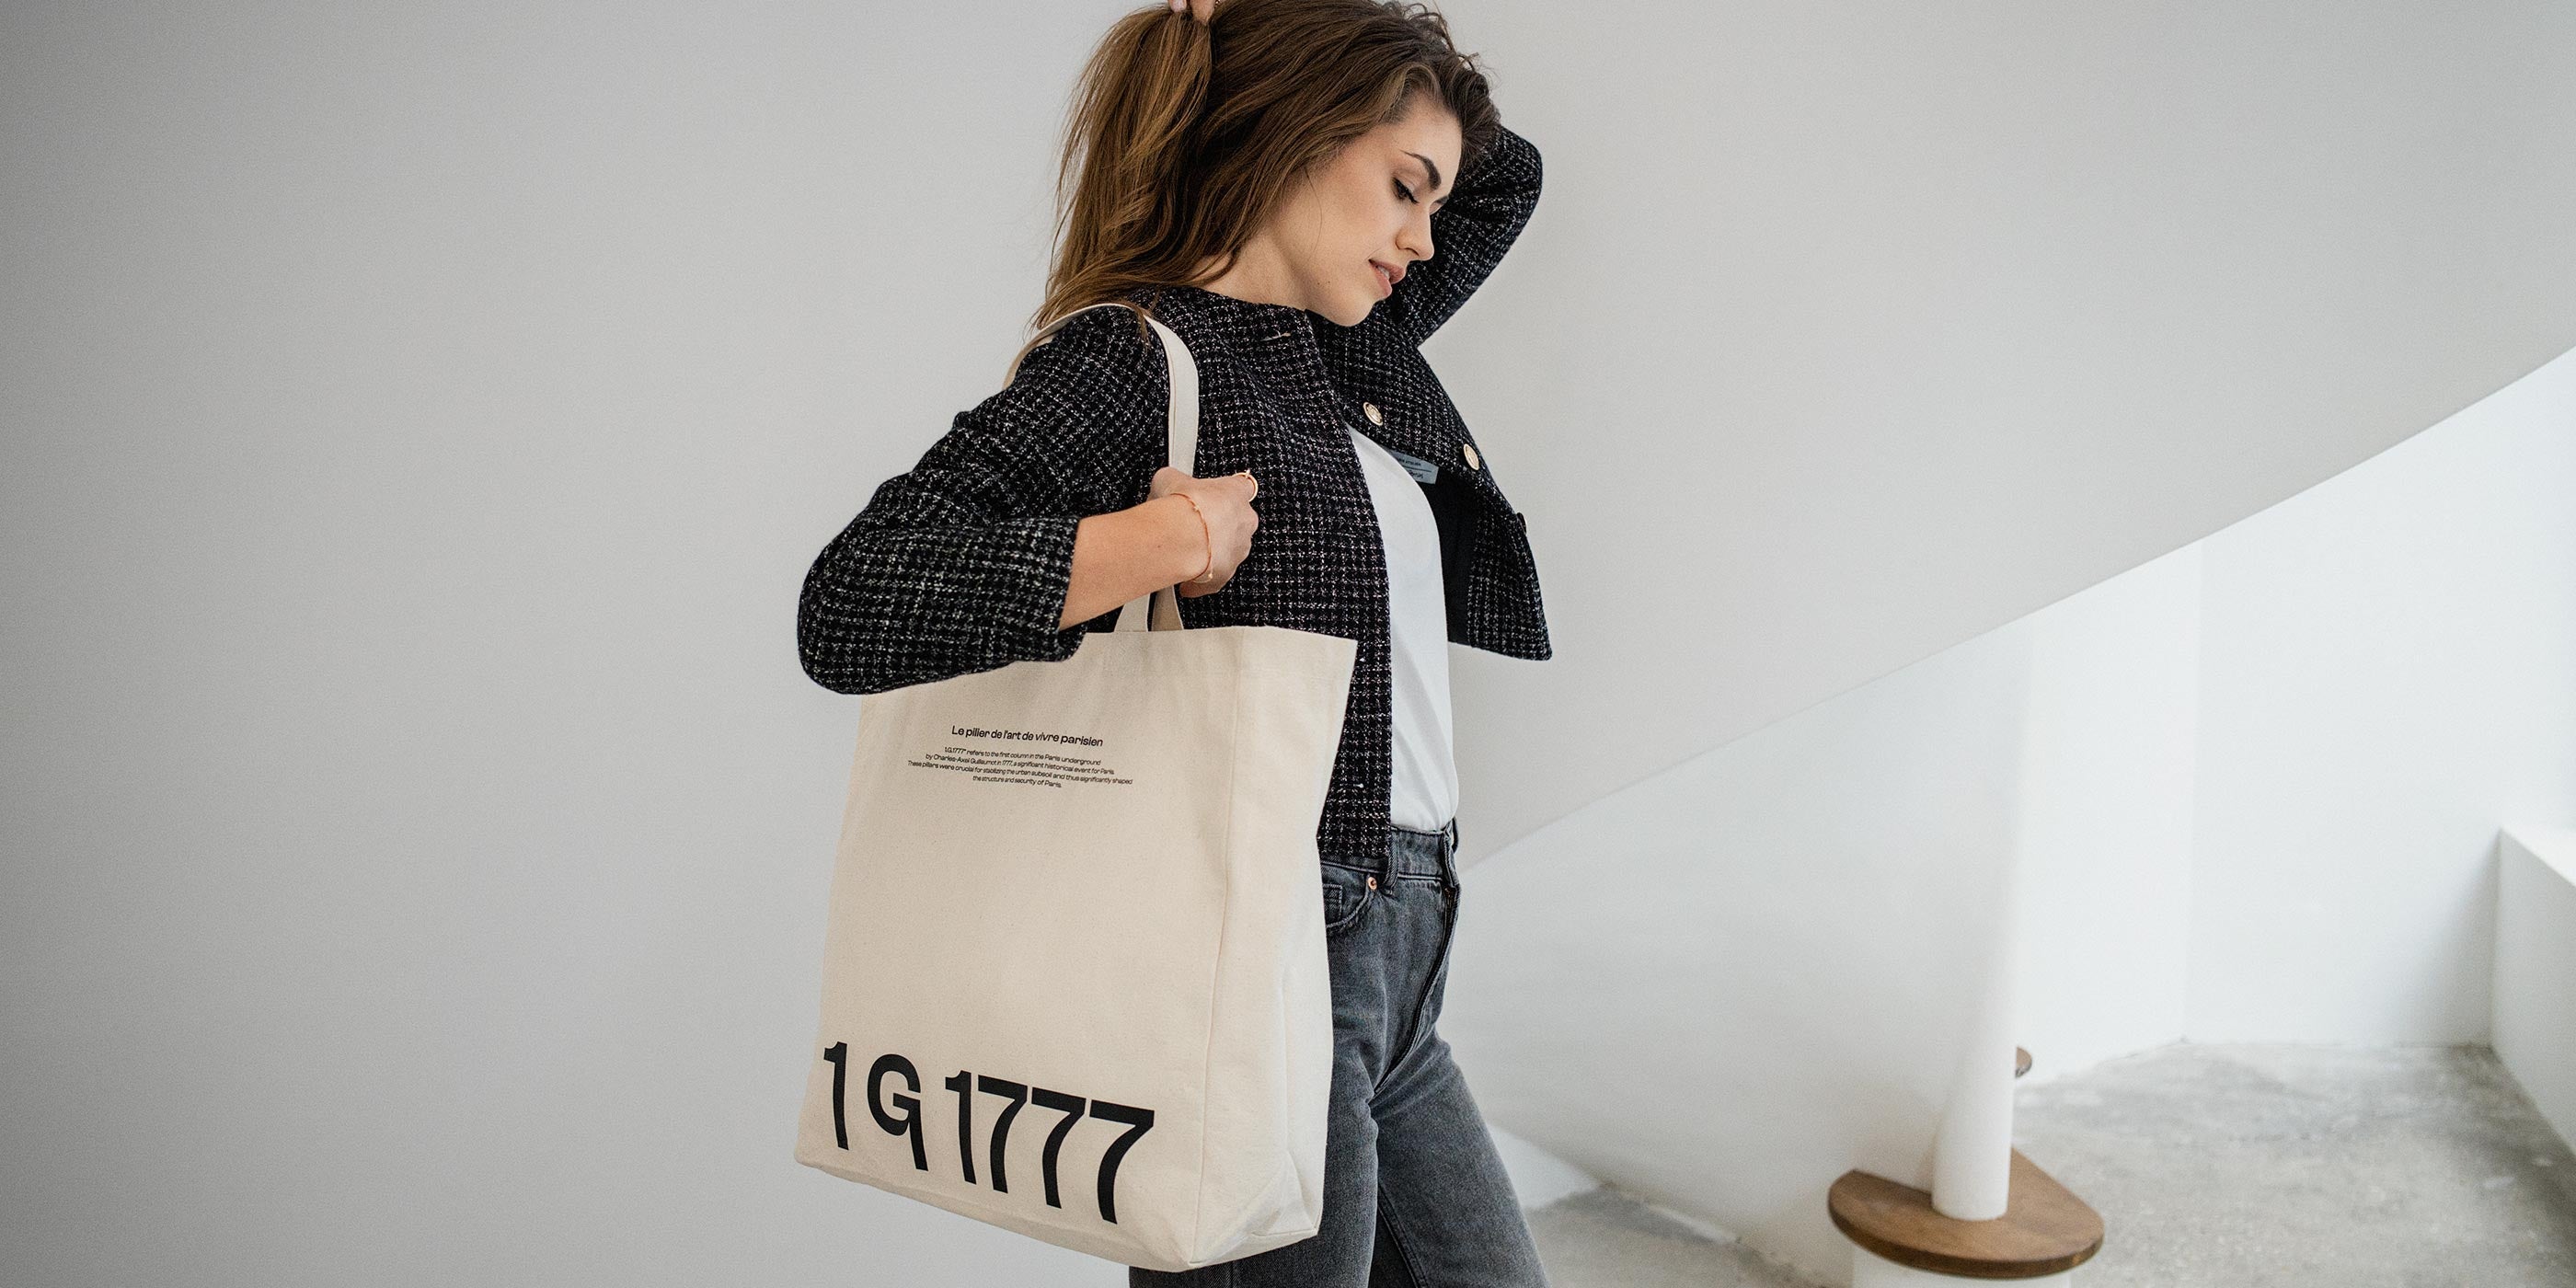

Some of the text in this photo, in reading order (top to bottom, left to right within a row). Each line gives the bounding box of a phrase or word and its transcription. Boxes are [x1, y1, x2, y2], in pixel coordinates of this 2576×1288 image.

[952, 725, 1103, 747] Le pilier de l'art de vivre parisien
[1061, 757, 1101, 766] underground
[1045, 763, 1074, 772] historical
[1080, 776, 1111, 784] significantly
[946, 1071, 1156, 1225] 1777
